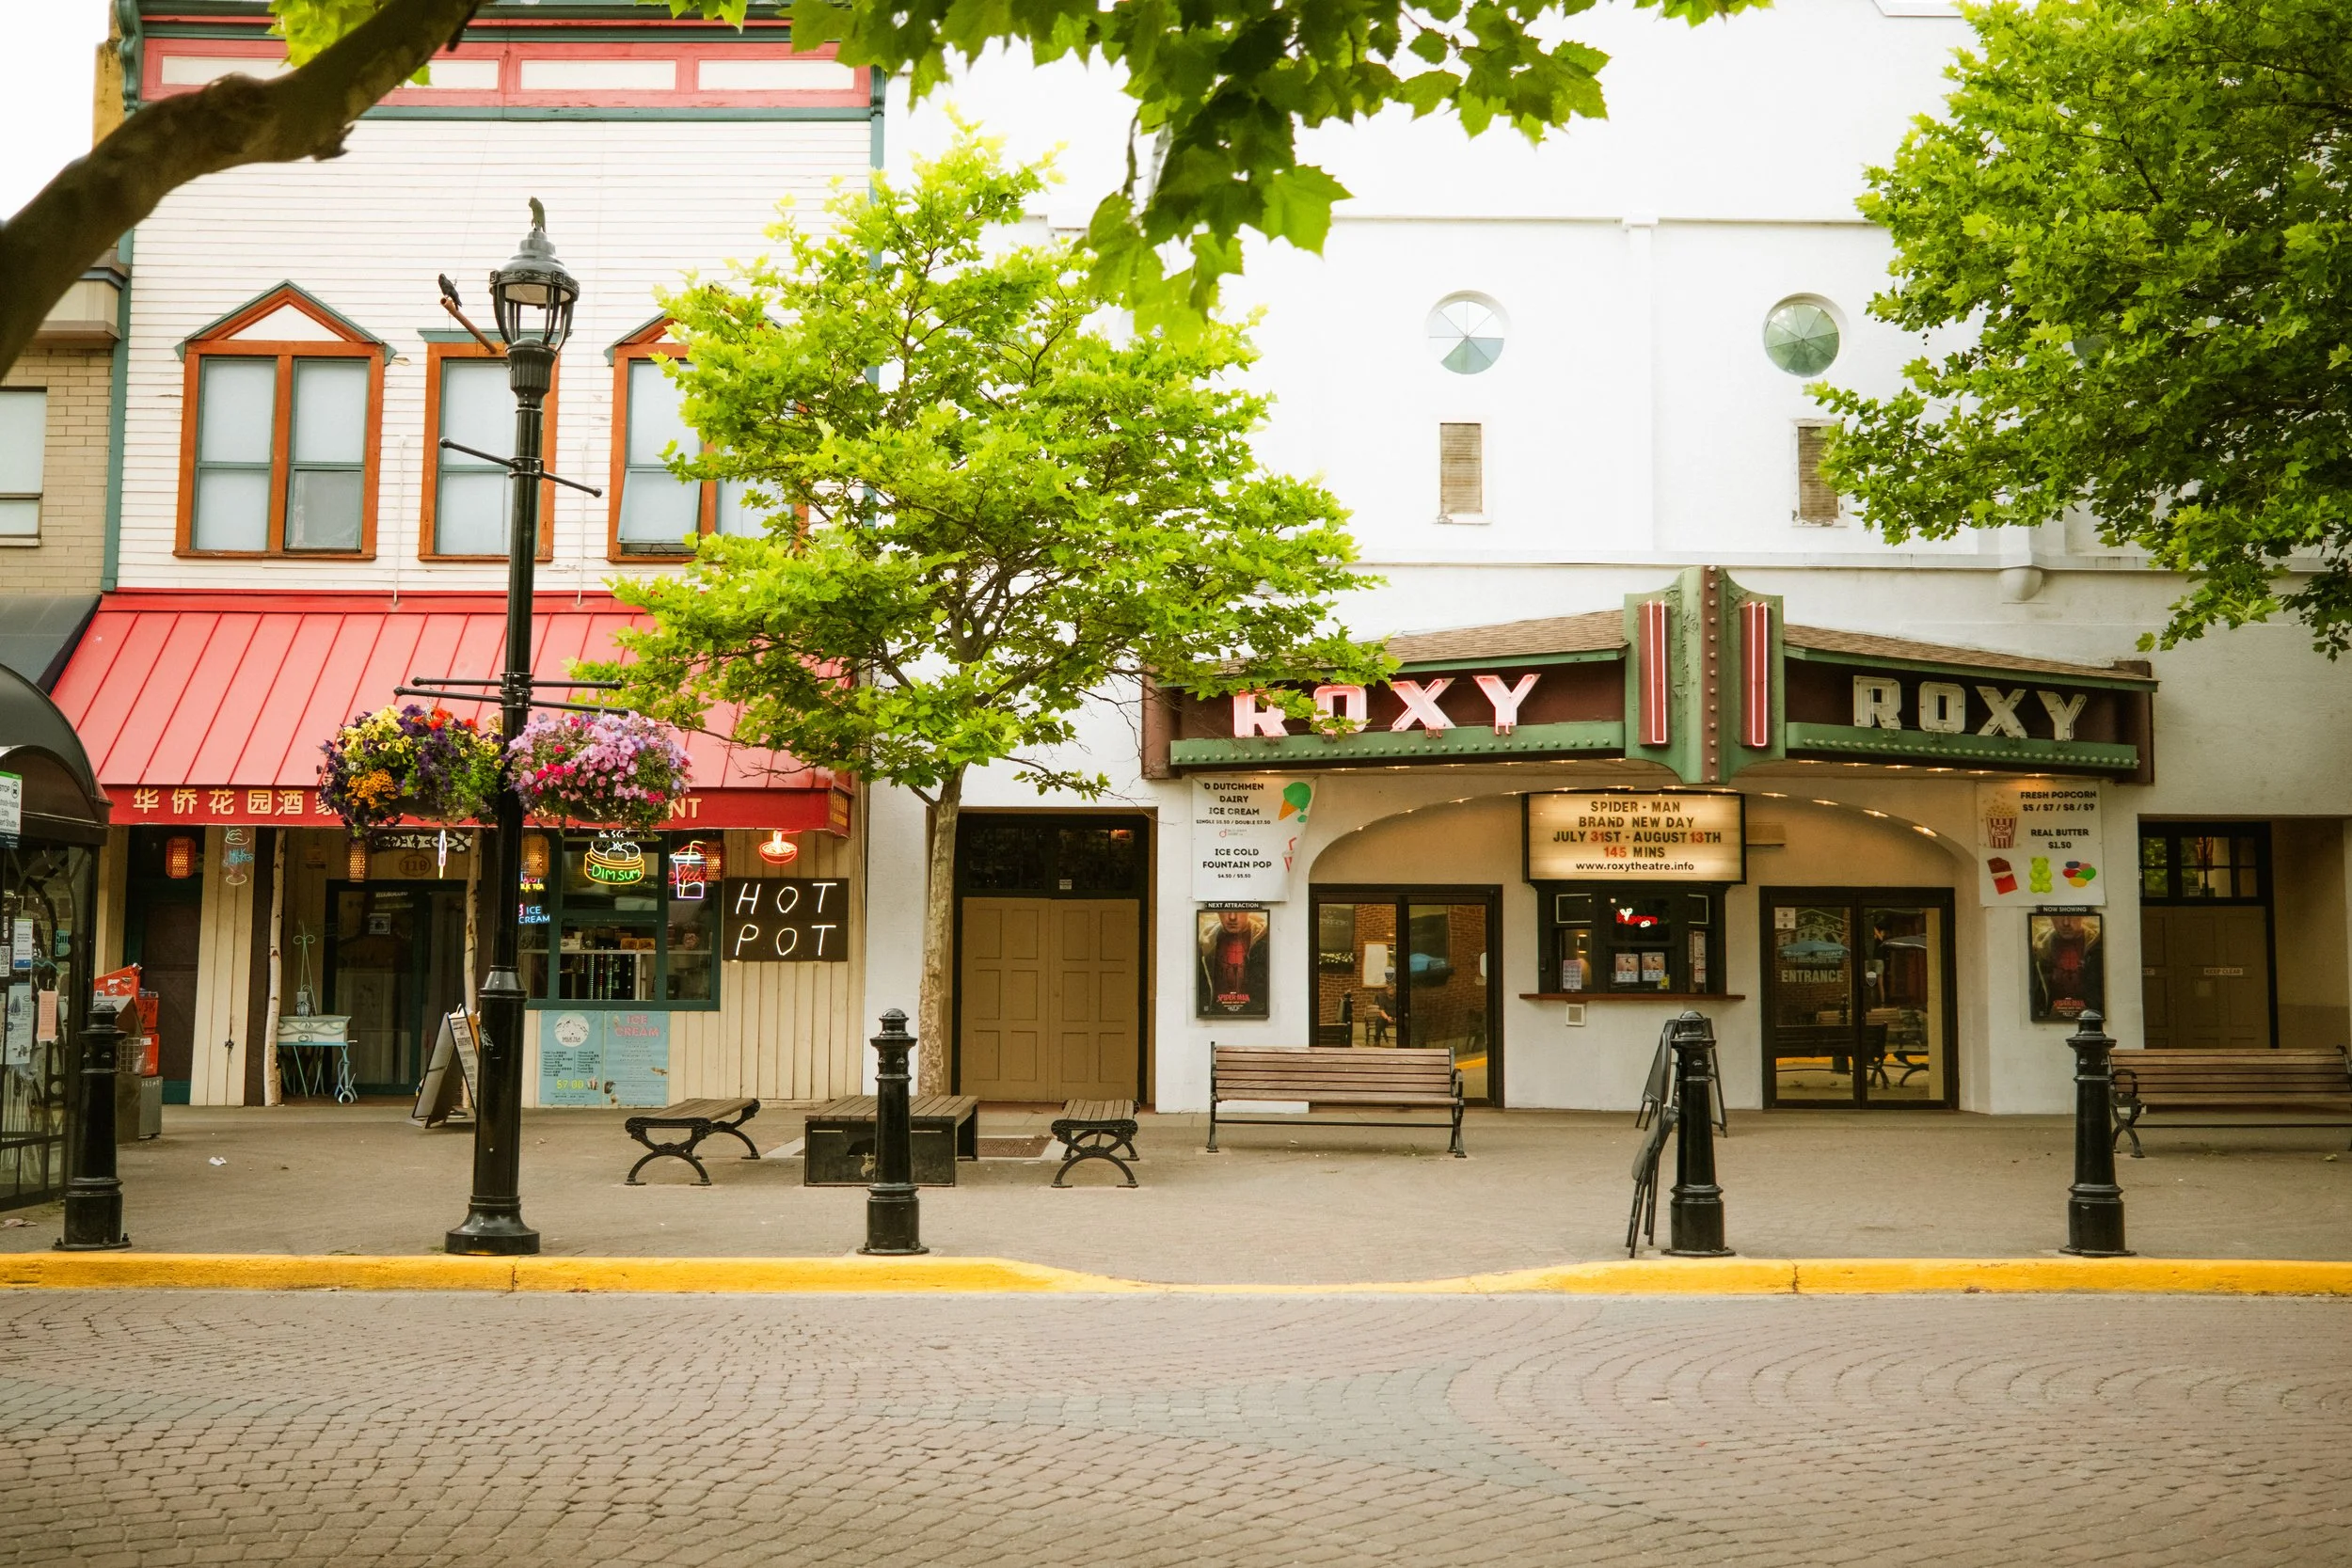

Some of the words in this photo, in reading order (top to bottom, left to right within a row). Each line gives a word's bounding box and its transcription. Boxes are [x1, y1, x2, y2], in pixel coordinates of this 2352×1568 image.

[1233, 673, 1541, 737] ROXY
[1853, 675, 2087, 741] ROXY
[1219, 795, 1249, 803] DAIRY
[1209, 807, 1225, 816] ICE
[1590, 800, 1638, 813] SPIDER
[1651, 800, 1680, 813] MAN
[2023, 803, 2034, 812] $5
[2042, 803, 2054, 812] $7
[2063, 803, 2074, 812] $8
[2083, 803, 2095, 812] $9
[1579, 816, 1625, 828] BRAND
[1631, 816, 1661, 828] NEW
[1666, 816, 1694, 828] DAY
[1553, 831, 1586, 843] JULY
[1590, 831, 1622, 843] 31ST
[1633, 832, 1687, 844] AUGUST
[1690, 832, 1722, 844] 13TH
[2048, 841, 2072, 849] $1.50
[1603, 847, 1627, 858] 145
[1632, 846, 1666, 858] MINS
[1202, 861, 1250, 869] FOUNTAIN
[1252, 861, 1272, 869] POP
[1576, 861, 1694, 872] www.roxytheatre.info
[591, 864, 616, 880] DIM
[620, 867, 641, 881] SUM
[736, 882, 837, 915] HOT
[526, 906, 542, 914] ICE
[518, 914, 550, 924] CREAM
[735, 924, 837, 957] POT
[1781, 970, 1845, 983] ENTRANCE
[627, 1014, 648, 1024] ICE
[614, 1026, 660, 1037] CREAM
